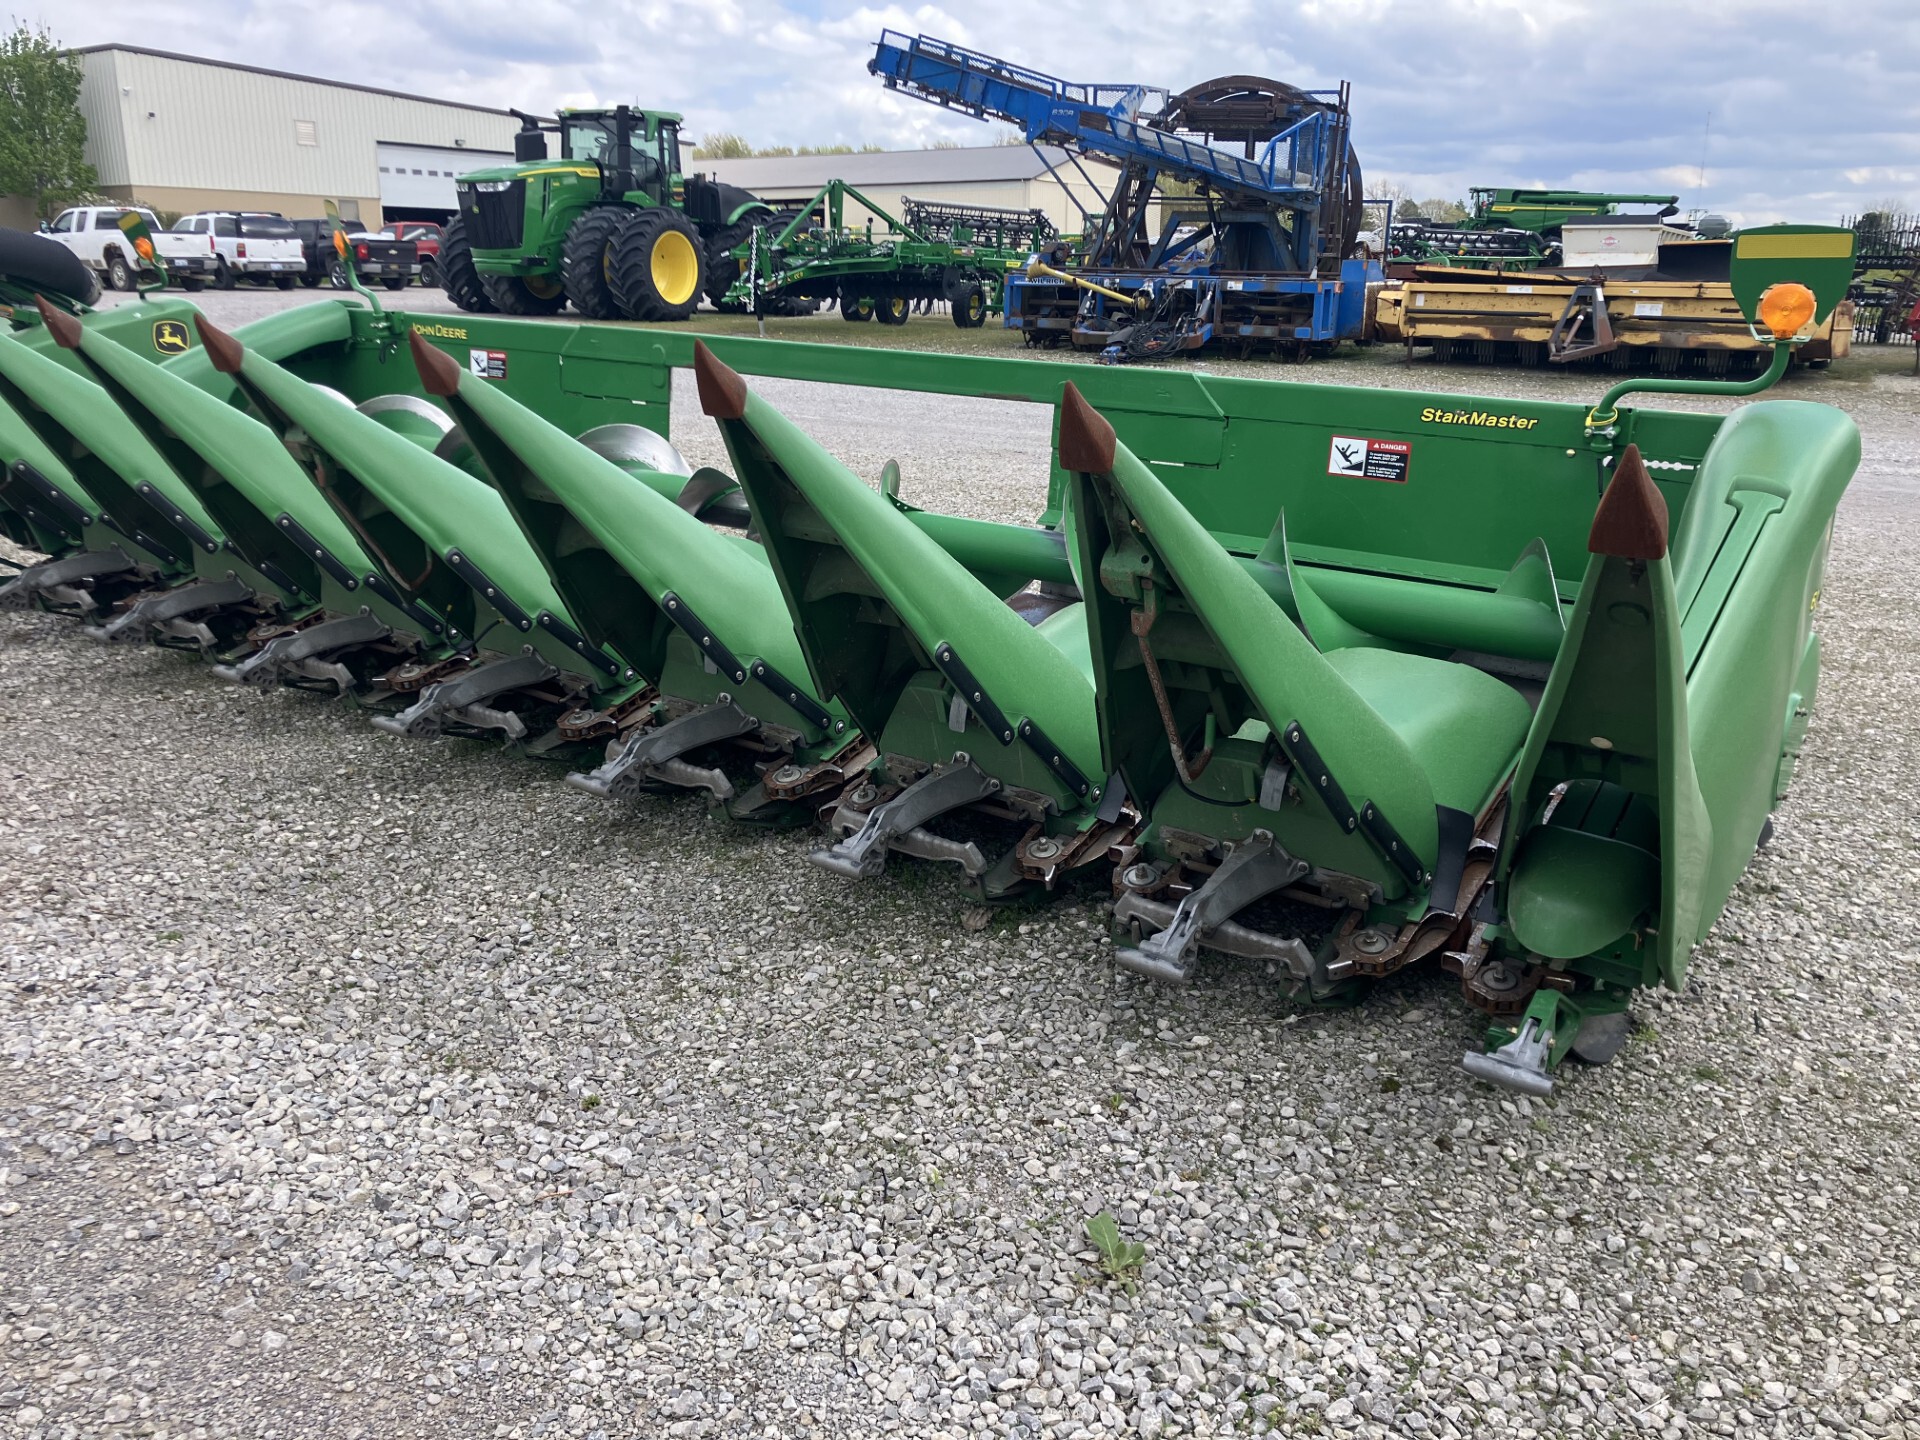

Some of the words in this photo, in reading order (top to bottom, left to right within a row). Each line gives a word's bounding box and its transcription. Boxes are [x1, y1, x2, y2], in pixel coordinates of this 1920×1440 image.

[413, 322, 435, 336] JOHN
[435, 324, 468, 339] DEERE
[1420, 407, 1538, 430] StalkMaster
[1380, 443, 1407, 451] DANGER
